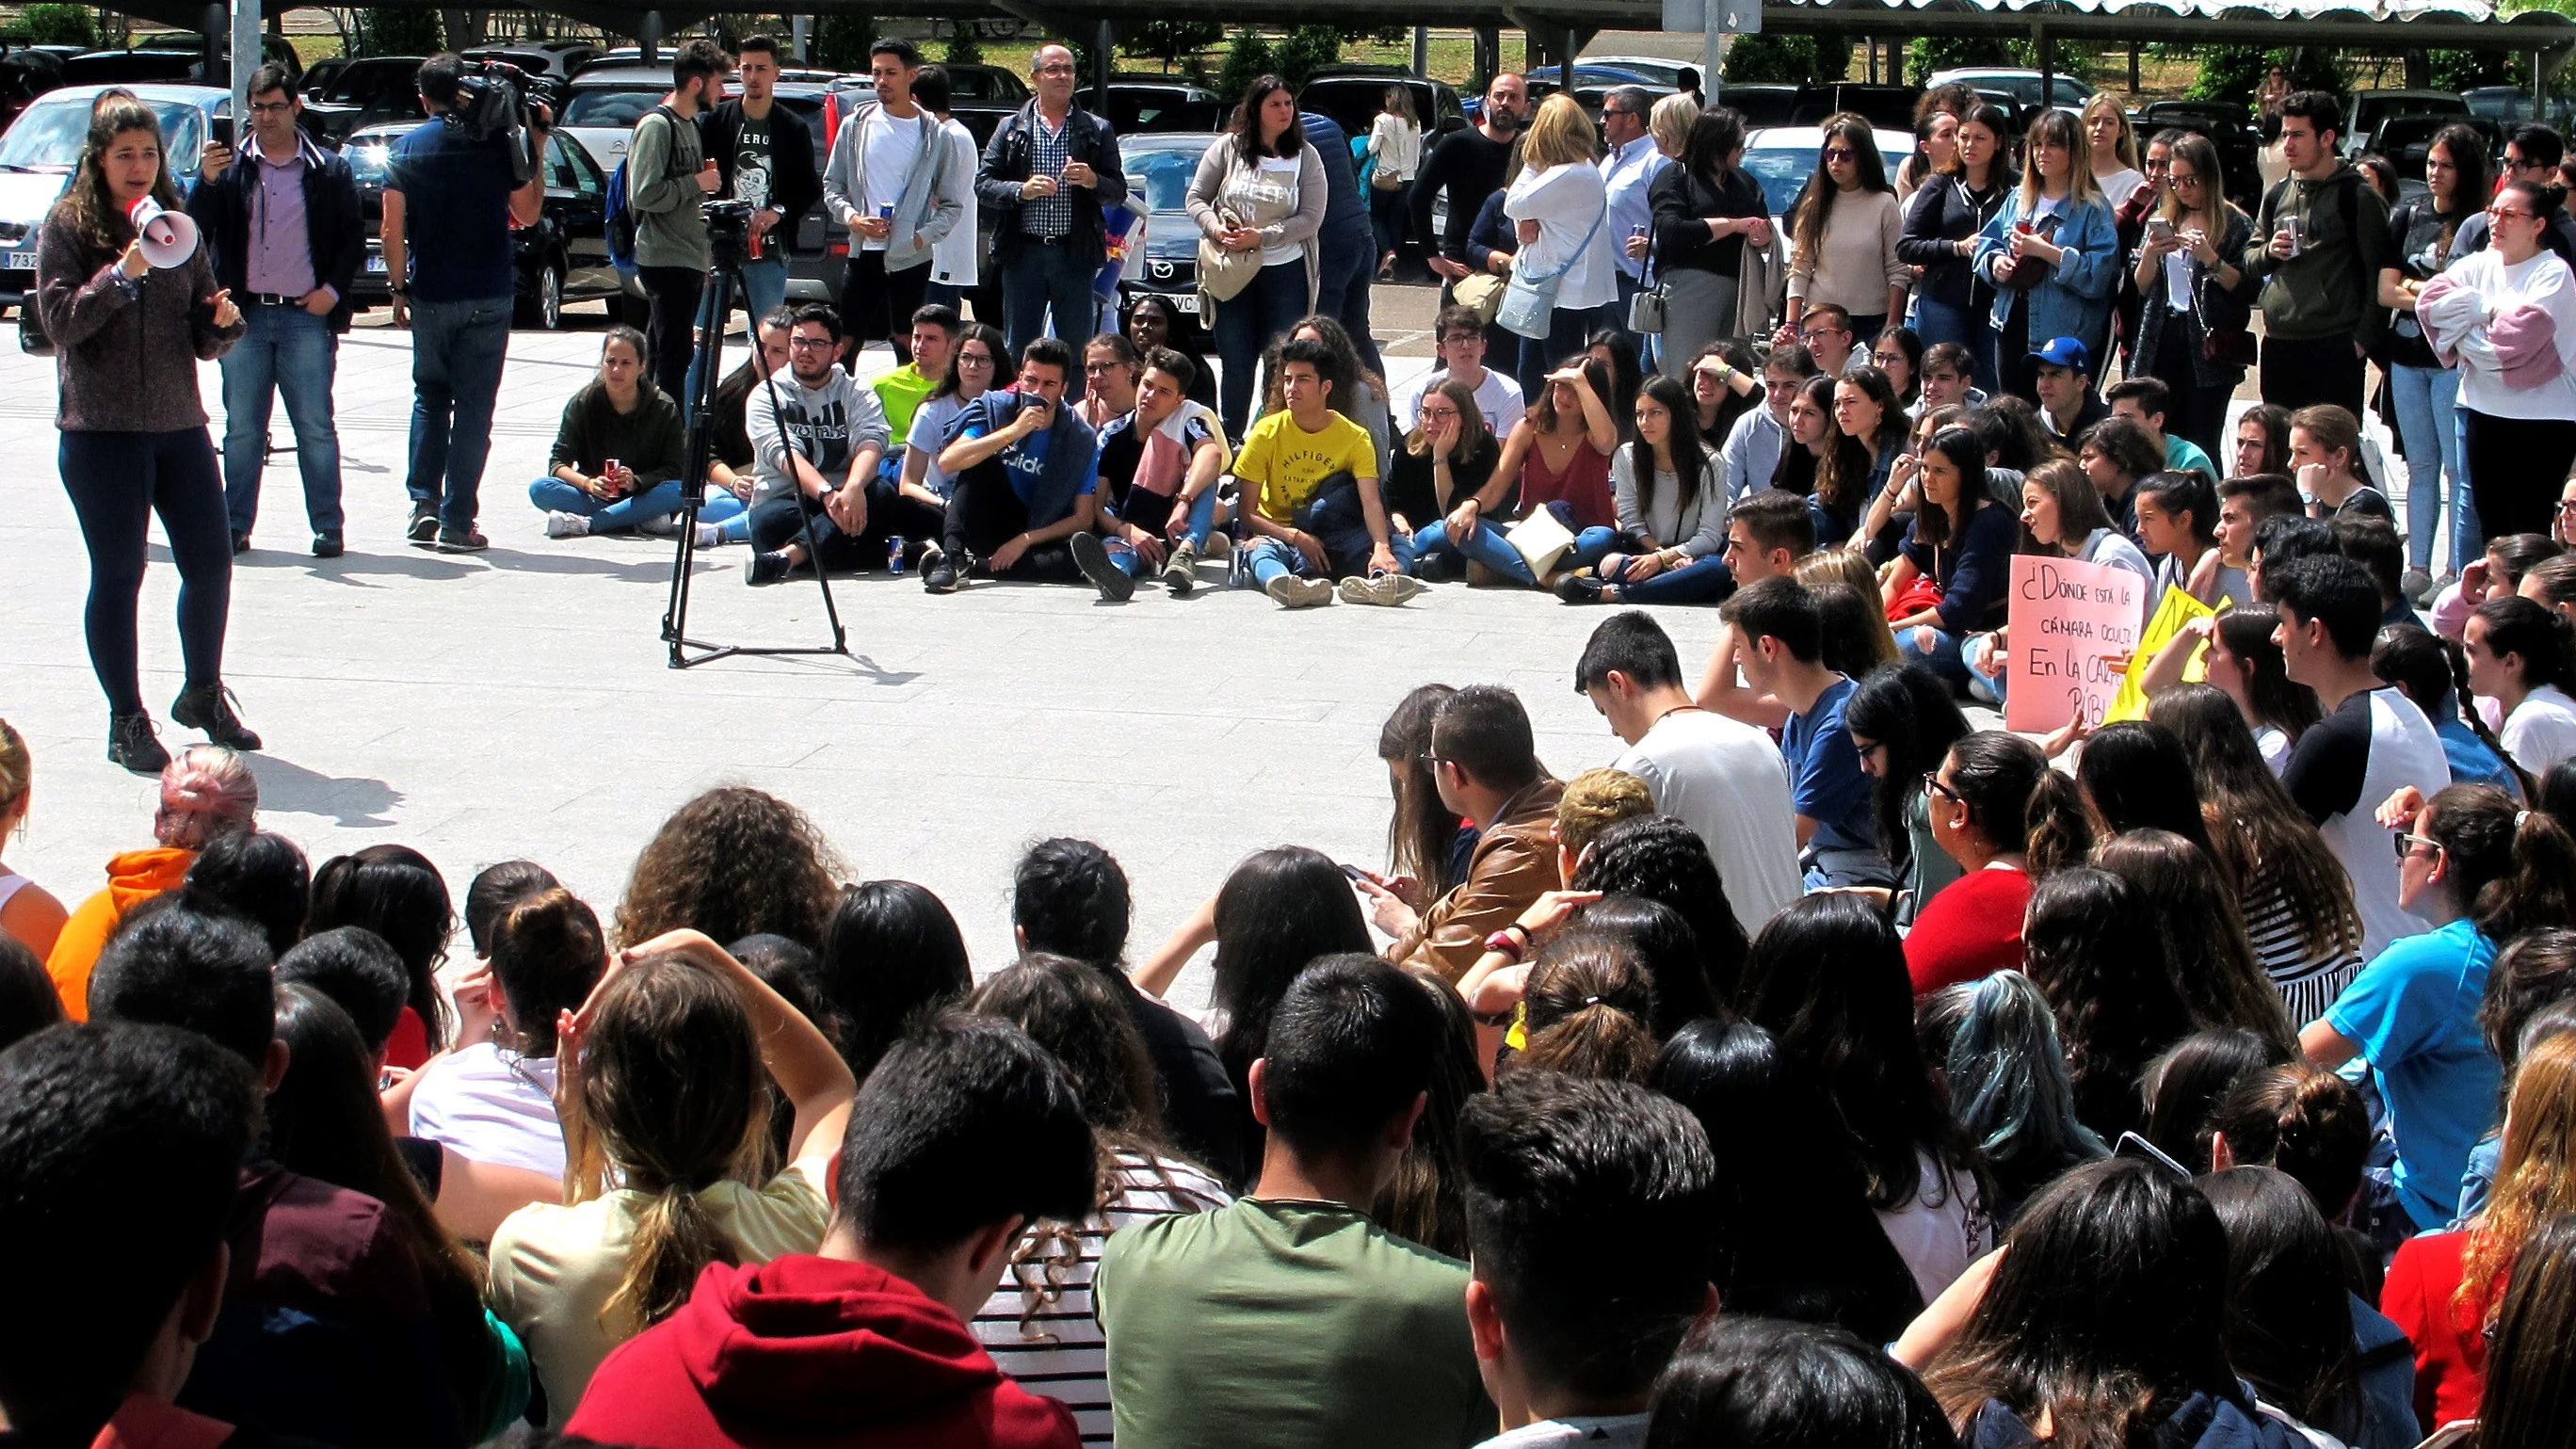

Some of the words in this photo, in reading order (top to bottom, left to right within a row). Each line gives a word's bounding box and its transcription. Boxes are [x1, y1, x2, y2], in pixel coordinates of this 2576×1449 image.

[2120, 586, 2131, 605] LA
[2040, 616, 2093, 638] CÁMARA
[2030, 648, 2057, 676] En
[2065, 649, 2081, 680] LA
